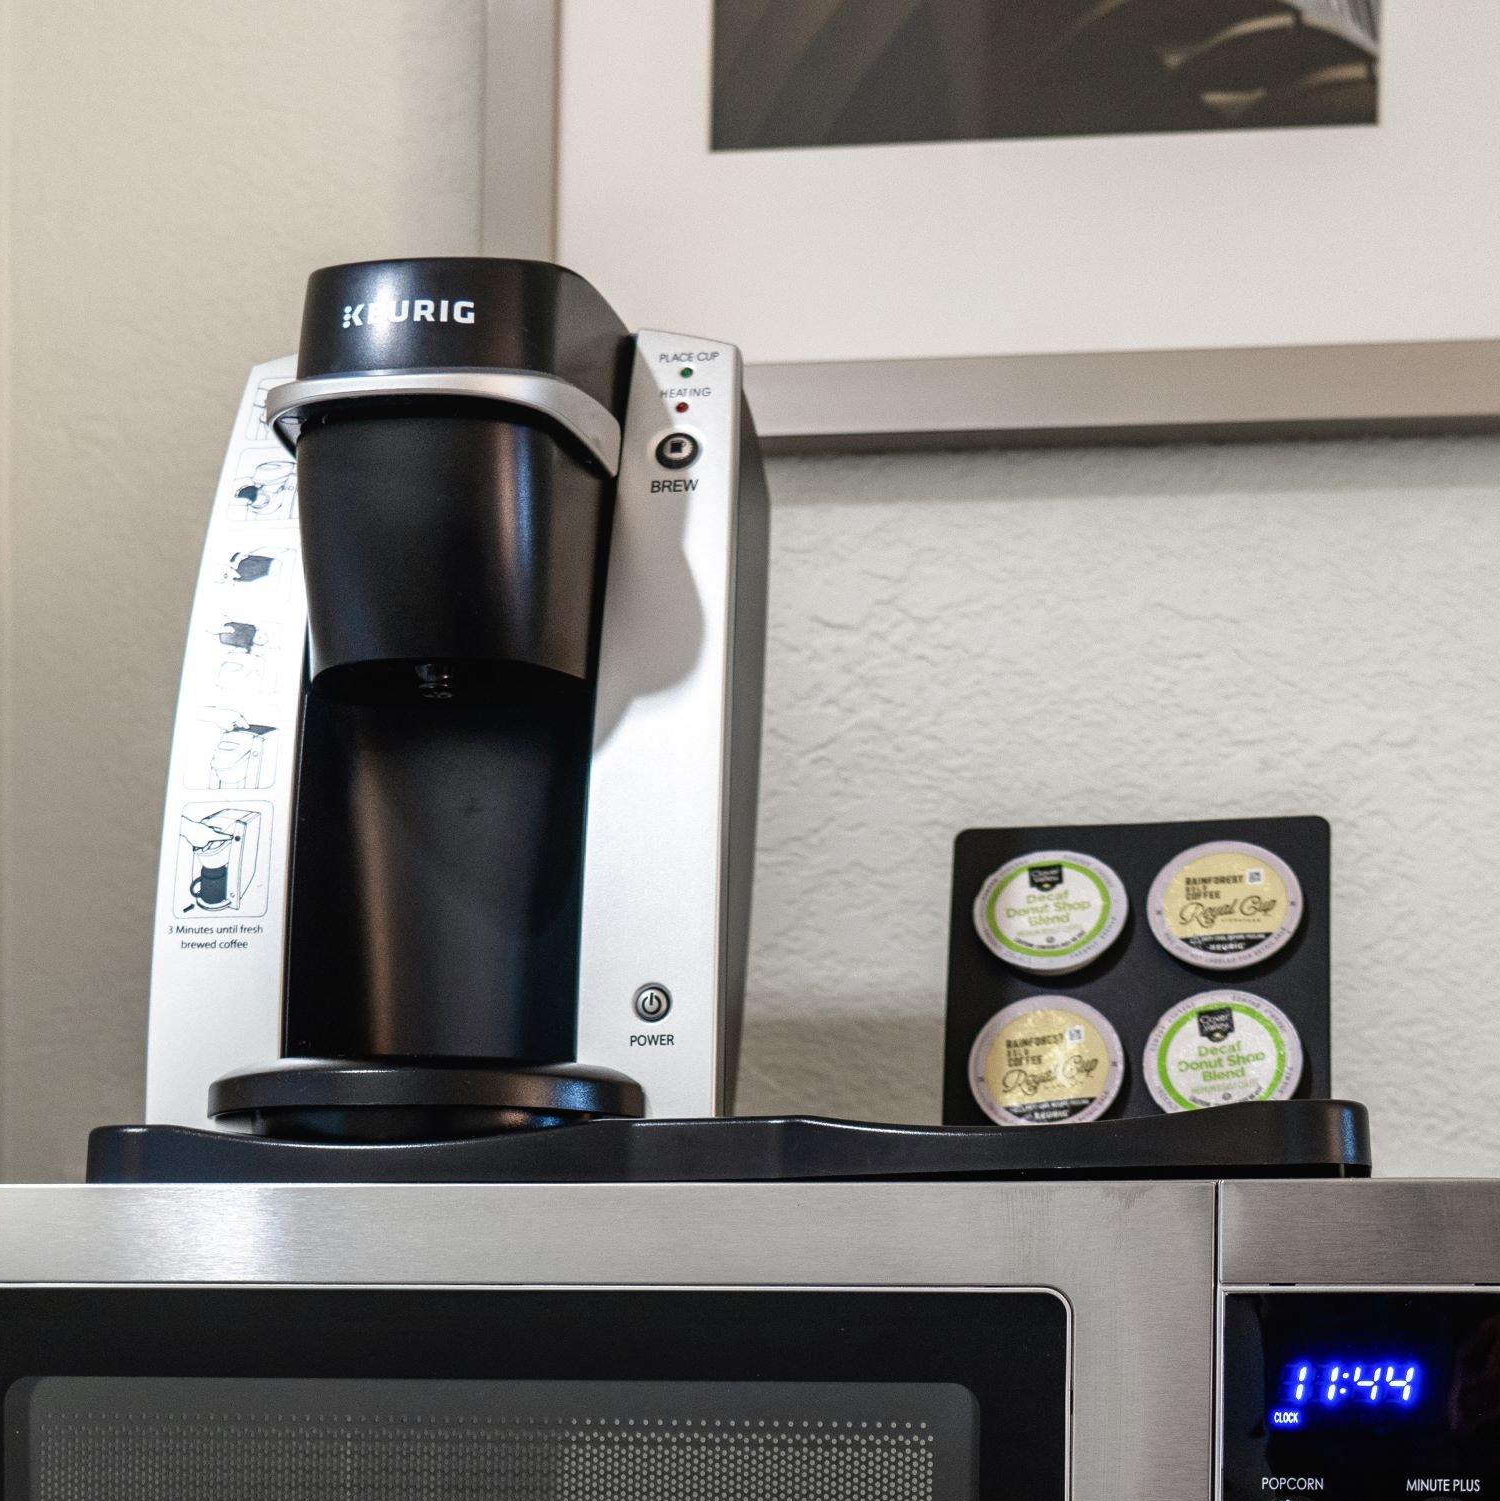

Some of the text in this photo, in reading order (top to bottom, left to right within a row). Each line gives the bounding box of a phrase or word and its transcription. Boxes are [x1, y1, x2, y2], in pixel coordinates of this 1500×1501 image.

[342, 299, 475, 328] KEURIG
[658, 351, 720, 363] PLACE CUP
[659, 386, 712, 399] HEATING
[650, 479, 699, 494] BREW
[1185, 875, 1244, 886] RAINFOREST
[1026, 889, 1069, 904] Decaf
[1186, 890, 1221, 901] COFFEE
[1005, 900, 1091, 918] Donut Shop
[1179, 897, 1238, 929] Royal
[168, 924, 264, 935] 3 Minutes until fresh
[180, 939, 248, 949] brewed coffee
[629, 1034, 675, 1047] POWER
[1197, 1040, 1242, 1057] Decaf
[1177, 1051, 1266, 1072] Donut Shop
[1202, 1067, 1245, 1081] Blend
[1295, 1366, 1415, 1401] 11:44
[1273, 1411, 1299, 1424] CLOCK
[1261, 1476, 1324, 1491] POPCORN
[1406, 1478, 1481, 1492] MINUTE PLUS
